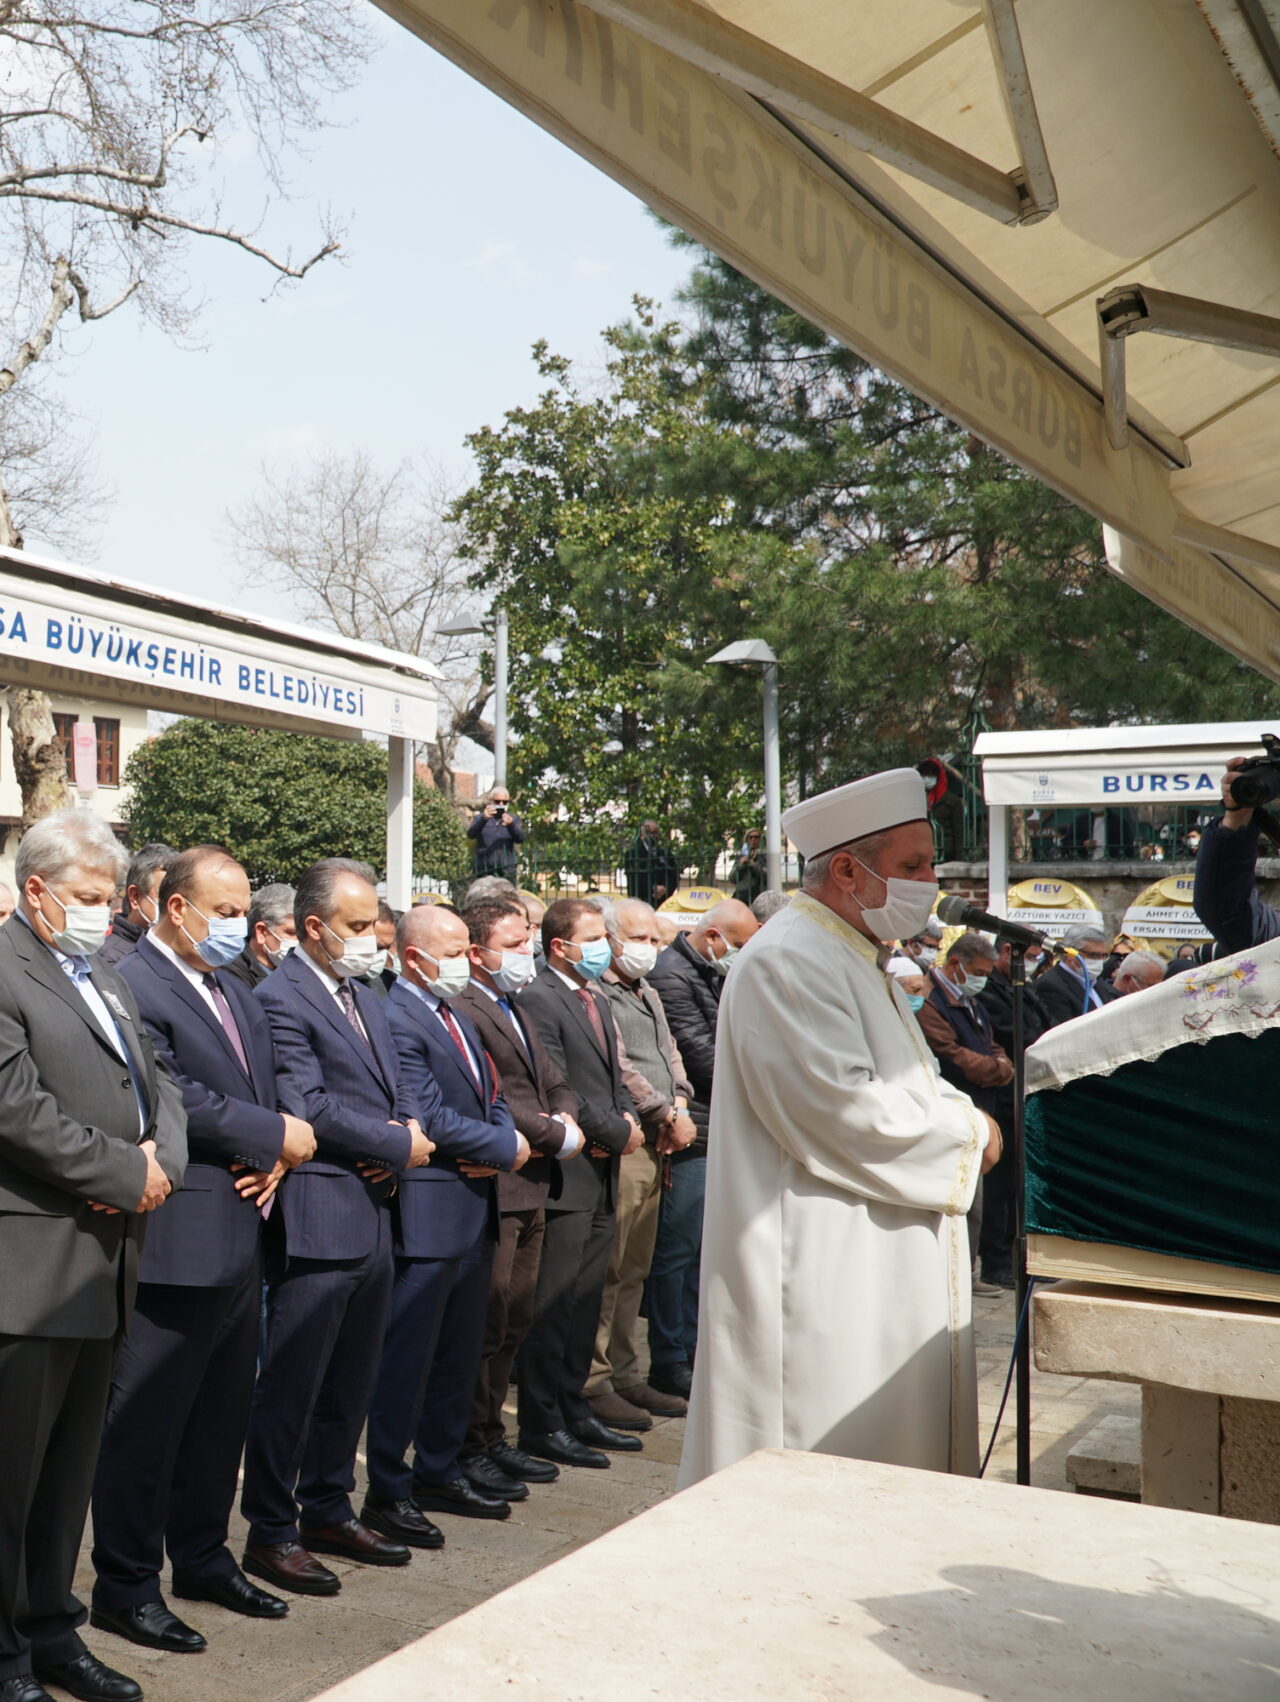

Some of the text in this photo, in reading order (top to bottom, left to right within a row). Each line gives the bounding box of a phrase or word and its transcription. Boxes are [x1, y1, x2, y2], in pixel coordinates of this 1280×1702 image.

[46, 616, 222, 685] BÜYÜKŞEHİR
[238, 664, 364, 717] BELEDİYESİ
[1102, 773, 1215, 794] BURSA
[1033, 883, 1062, 894] BEV
[1176, 880, 1194, 890] BE
[690, 891, 712, 900] BEV
[1054, 912, 1086, 920] YAZICI
[1133, 925, 1212, 936] ERSAN TÜRKDÖ
